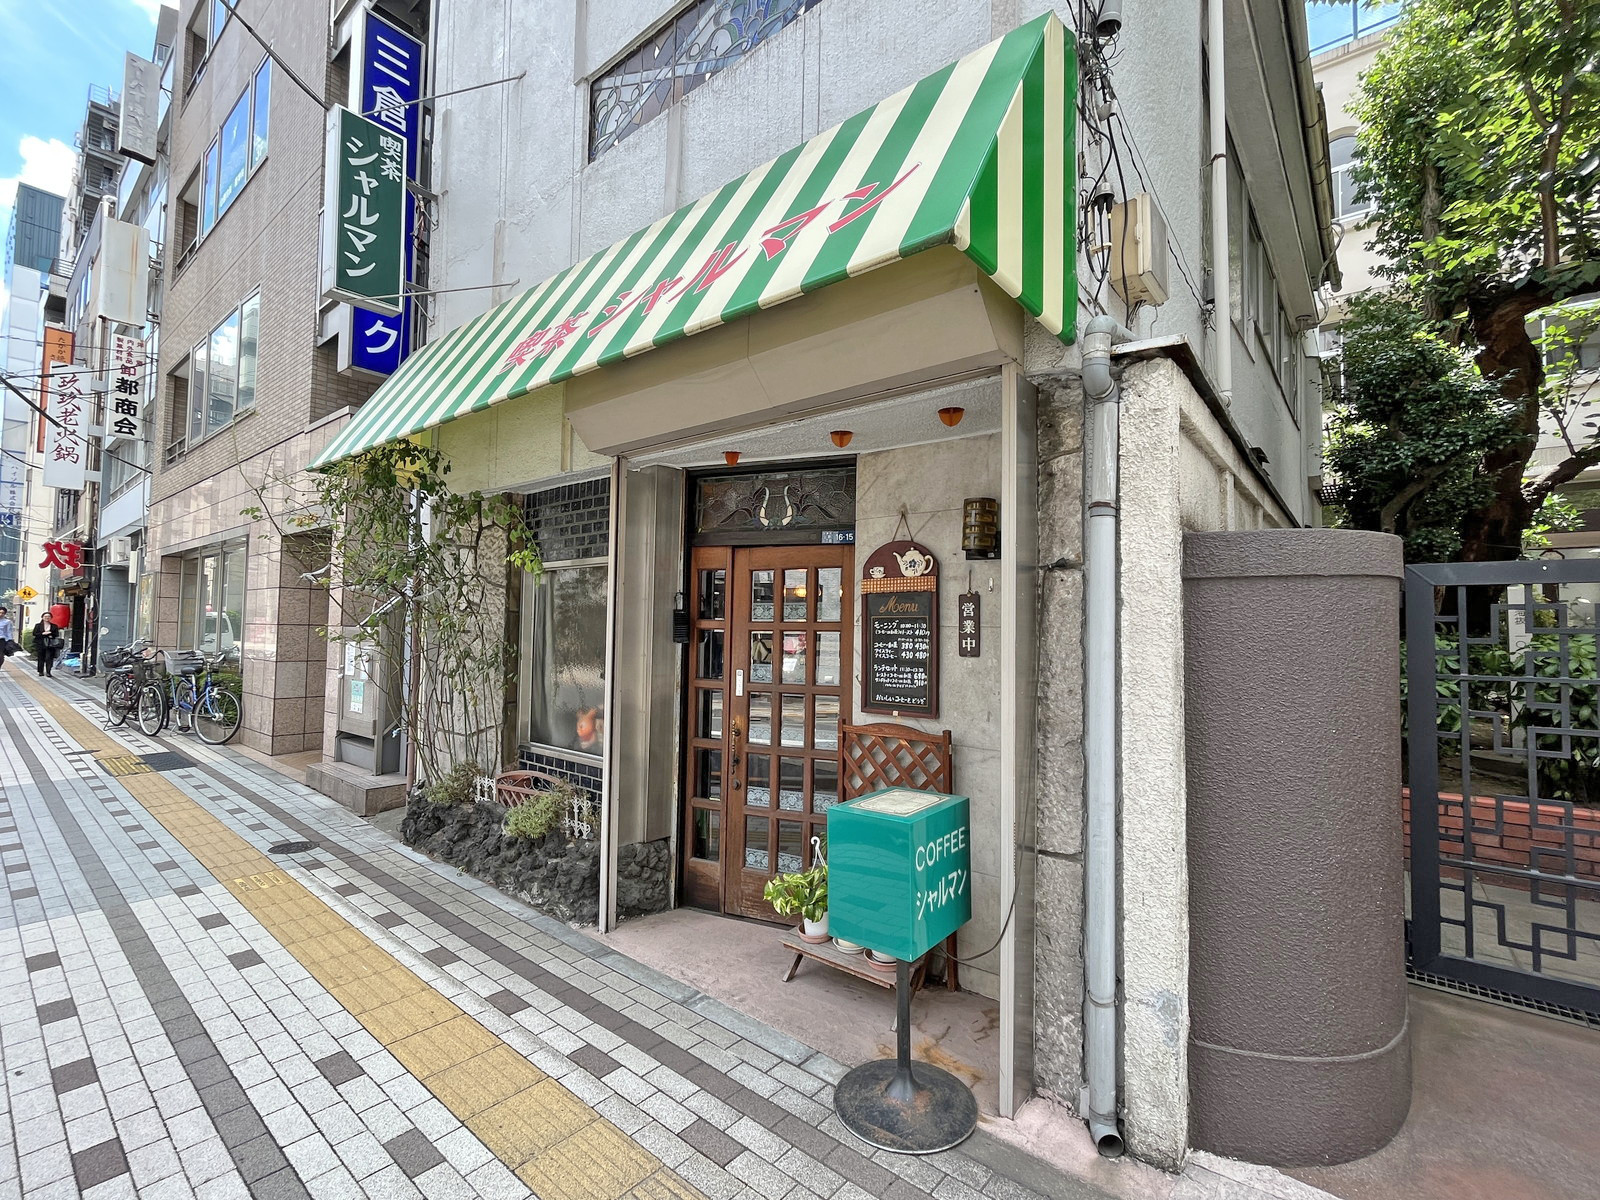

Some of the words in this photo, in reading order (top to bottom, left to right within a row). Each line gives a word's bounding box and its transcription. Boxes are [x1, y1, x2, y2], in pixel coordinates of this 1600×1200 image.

[373, 34, 411, 133] 三倉
[379, 134, 402, 183] 喫茶
[342, 136, 380, 277] シャルマン
[586, 161, 923, 339] シャルマン
[498, 309, 591, 375] 喫茶
[51, 372, 83, 465] 玖玖老火鍋
[114, 377, 139, 437] 都商会
[874, 620, 899, 629] モーニング
[879, 595, 919, 613] Menu
[960, 602, 976, 652] 営業中
[915, 826, 966, 872] COFFEE
[915, 869, 967, 921] シャルマン
